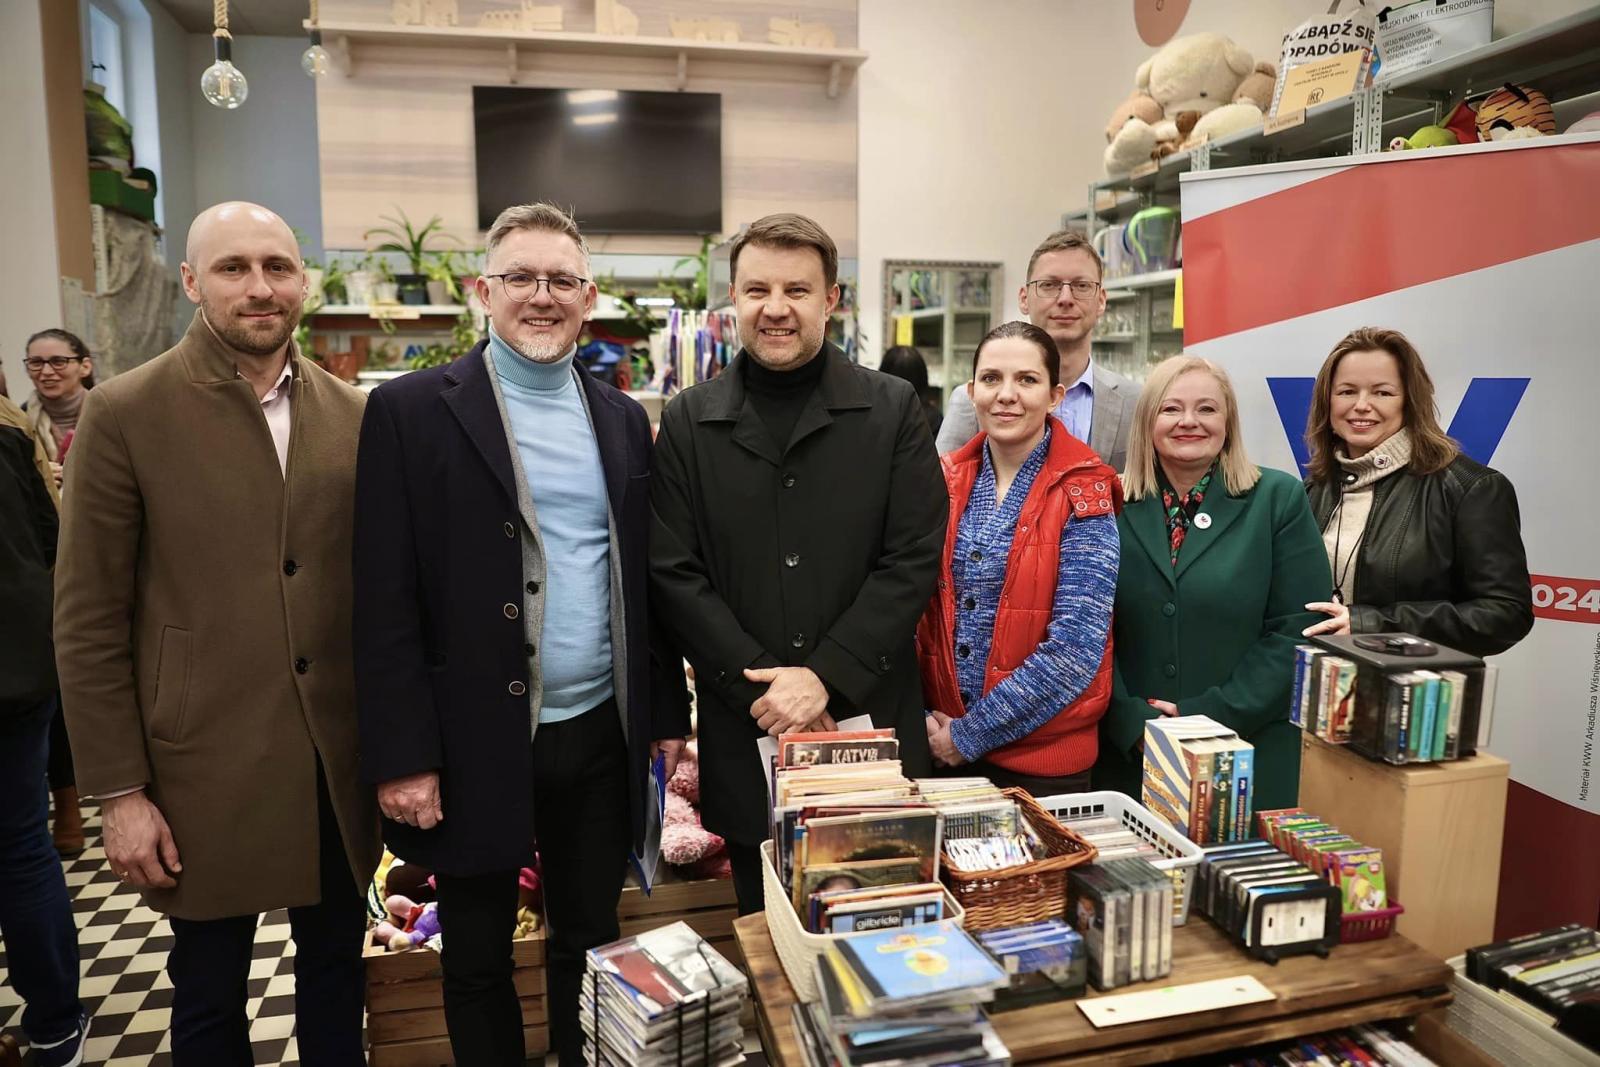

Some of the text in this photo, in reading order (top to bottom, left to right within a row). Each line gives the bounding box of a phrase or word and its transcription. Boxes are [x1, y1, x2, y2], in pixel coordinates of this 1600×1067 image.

[1402, 11, 1424, 25] PUNKT
[1426, 0, 1493, 16] ELEKTROODPAD
[1282, 19, 1353, 46] ZBĄDŹ
[1585, 695, 1598, 741] Arkadiusza
[1582, 742, 1593, 767] KWW
[1579, 769, 1591, 802] Materiał
